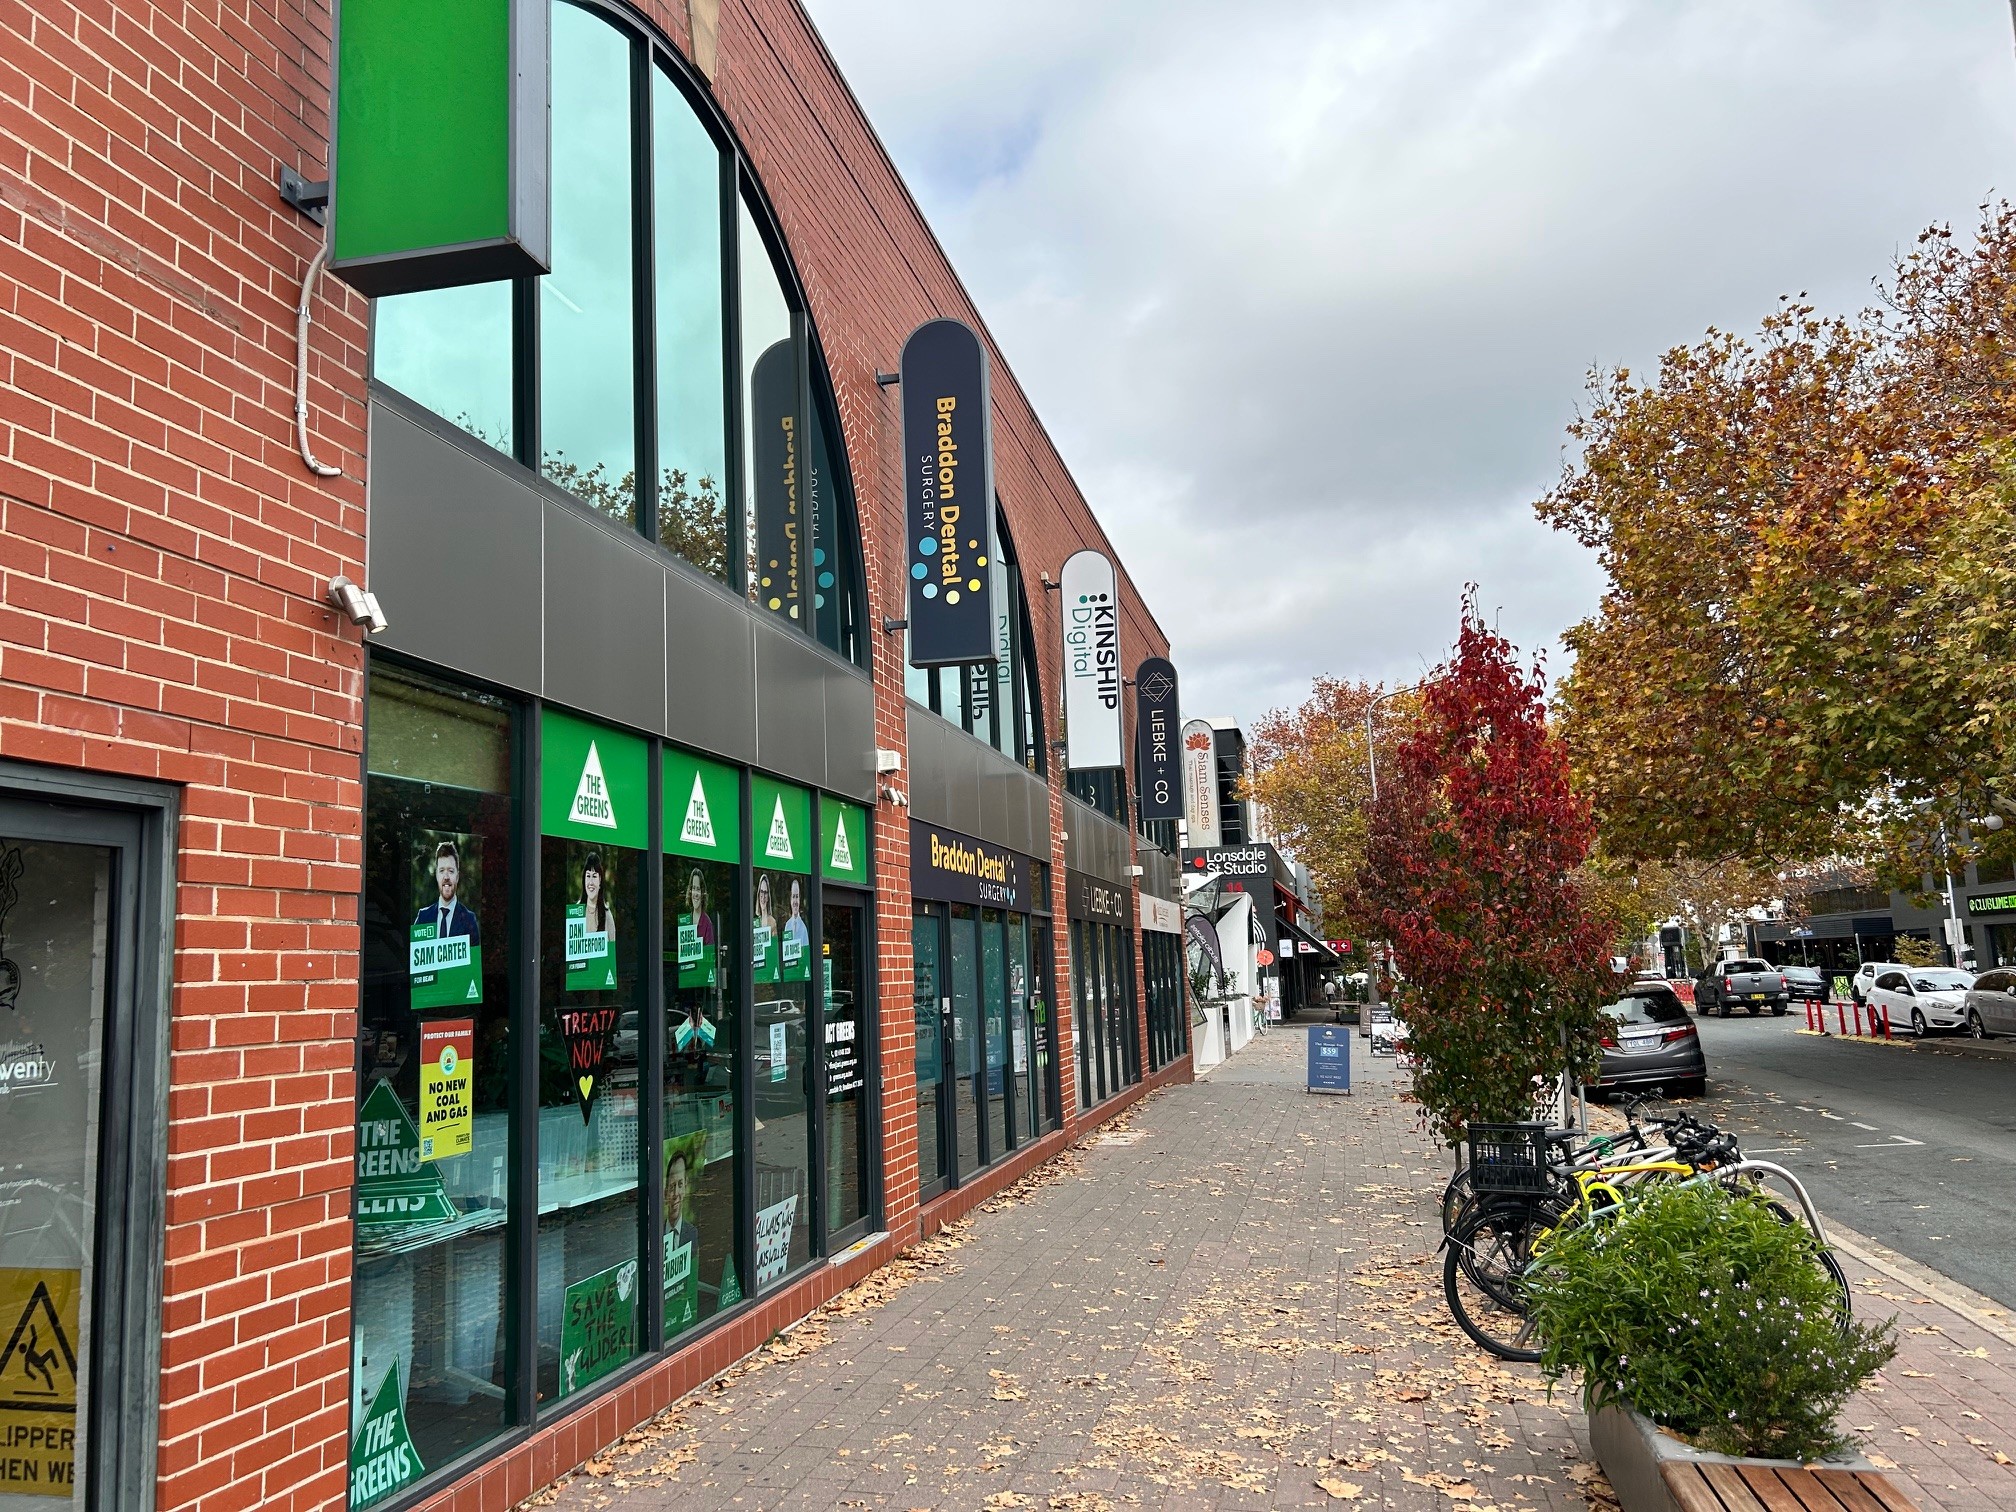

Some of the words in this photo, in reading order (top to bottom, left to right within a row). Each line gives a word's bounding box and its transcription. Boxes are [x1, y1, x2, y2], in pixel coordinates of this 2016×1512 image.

[936, 397, 958, 499] Braddon
[921, 455, 935, 531] SURGERY
[940, 505, 962, 586] Dental
[1066, 608, 1097, 678] Digital
[1094, 605, 1118, 710] KINSHIP
[1151, 709, 1167, 763] LIEBKE
[1157, 767, 1165, 775] +
[1197, 752, 1209, 784] Siam
[586, 774, 601, 795] THE
[1154, 779, 1169, 804] CO
[577, 795, 609, 819] GREENS
[692, 800, 704, 813] THE
[1199, 786, 1211, 831] Senses
[686, 818, 710, 838] GREENS
[775, 819, 784, 835] THE
[769, 835, 789, 853] GREENS
[1206, 847, 1266, 863] Lonsdale
[834, 848, 849, 865] GREENS
[931, 833, 976, 876] Braddon
[977, 847, 1006, 883] Dental
[1223, 861, 1267, 875] Studio
[979, 882, 1006, 902] SURGERY
[1090, 886, 1110, 915] LIEBKE
[414, 929, 427, 937] VOTE
[569, 923, 584, 939] DANI
[414, 946, 435, 966] SAM
[437, 942, 467, 962] CARTER
[569, 937, 605, 955] HUNTERFORD
[562, 1010, 616, 1036] TREATY
[573, 1039, 604, 1069] NOW
[429, 1083, 444, 1094] NO
[446, 1078, 467, 1092] NEW
[436, 1093, 460, 1107] COAL
[426, 1110, 447, 1123] AND
[449, 1106, 468, 1119] GAS
[360, 1119, 401, 1146] THE
[572, 1282, 619, 1326] SAVE
[585, 1308, 618, 1342] THE
[0, 1425, 74, 1450] IPPER
[364, 1408, 398, 1457] THE
